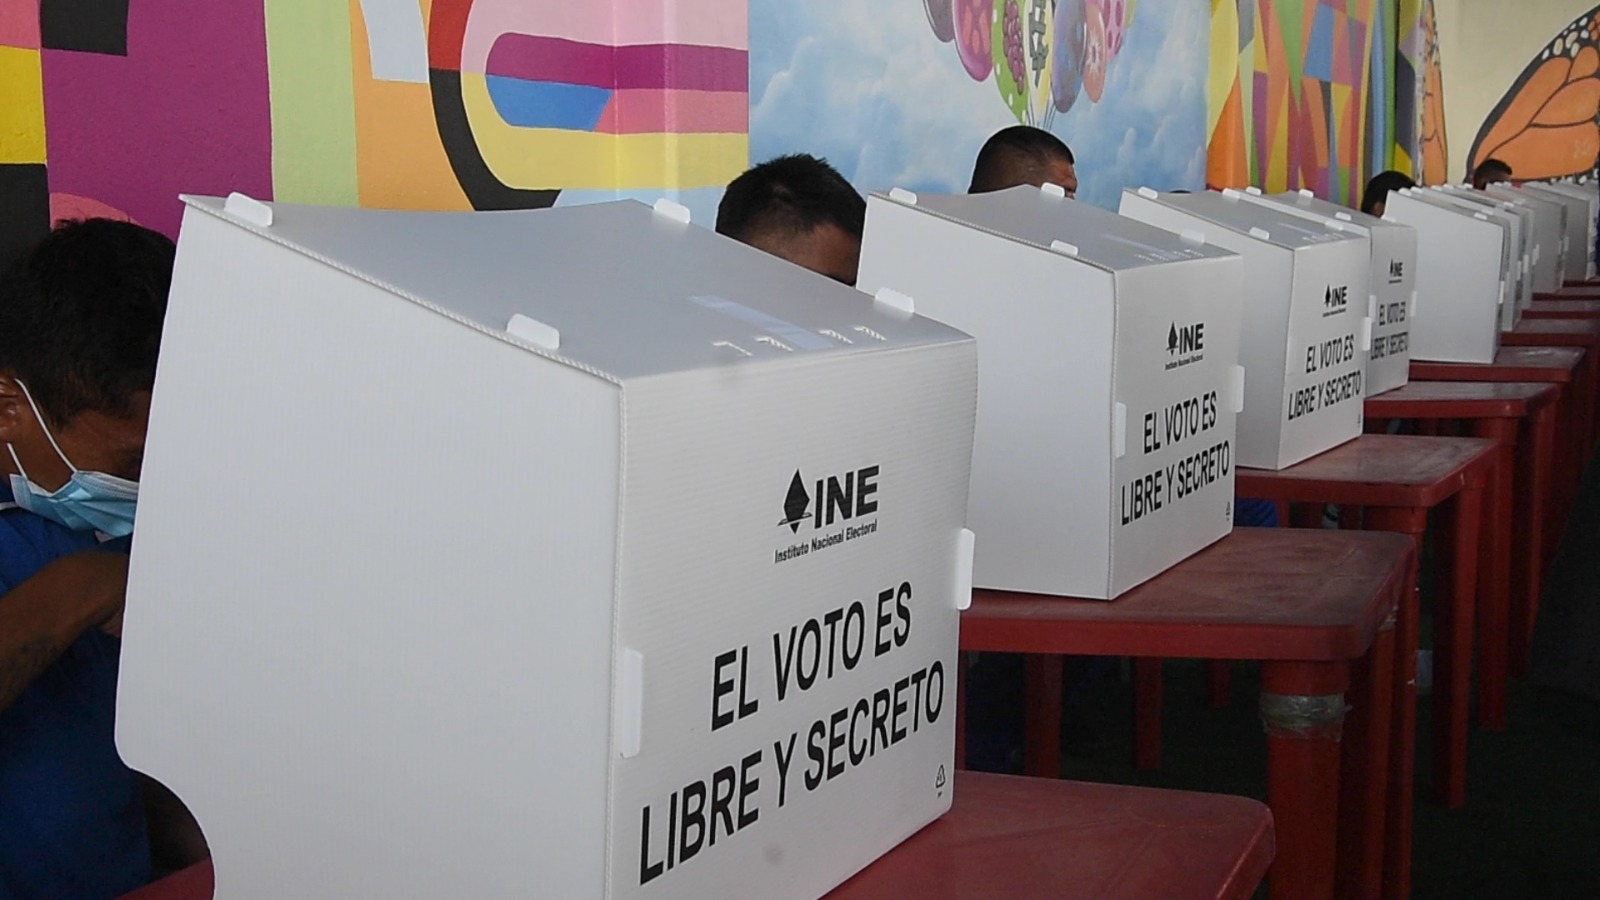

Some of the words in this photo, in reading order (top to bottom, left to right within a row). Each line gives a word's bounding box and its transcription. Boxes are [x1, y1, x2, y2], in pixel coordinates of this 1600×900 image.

[1331, 286, 1347, 307] INE
[1179, 322, 1204, 355] INE
[1306, 345, 1317, 374] EL
[1320, 337, 1343, 369] VOTO
[1344, 334, 1354, 361] ES
[1144, 411, 1161, 454] EL
[1165, 397, 1199, 446] VOTO
[1202, 390, 1217, 431] ES
[1288, 385, 1316, 420] LIBRE
[1318, 382, 1325, 410] Y
[1324, 370, 1361, 407] SECRETO
[814, 465, 879, 529] INE
[1121, 469, 1162, 526] LIBRE
[1166, 464, 1175, 504] Y
[1177, 440, 1230, 500] SECRETO
[775, 542, 809, 564] Instituto
[811, 529, 844, 552] Nacional
[846, 518, 877, 541] Electoral
[711, 645, 759, 731] EL
[773, 601, 865, 701] VOTO
[874, 581, 912, 658] ES
[639, 749, 762, 886] LIBRE
[773, 732, 798, 808] Y
[804, 660, 944, 792] SECRETO
